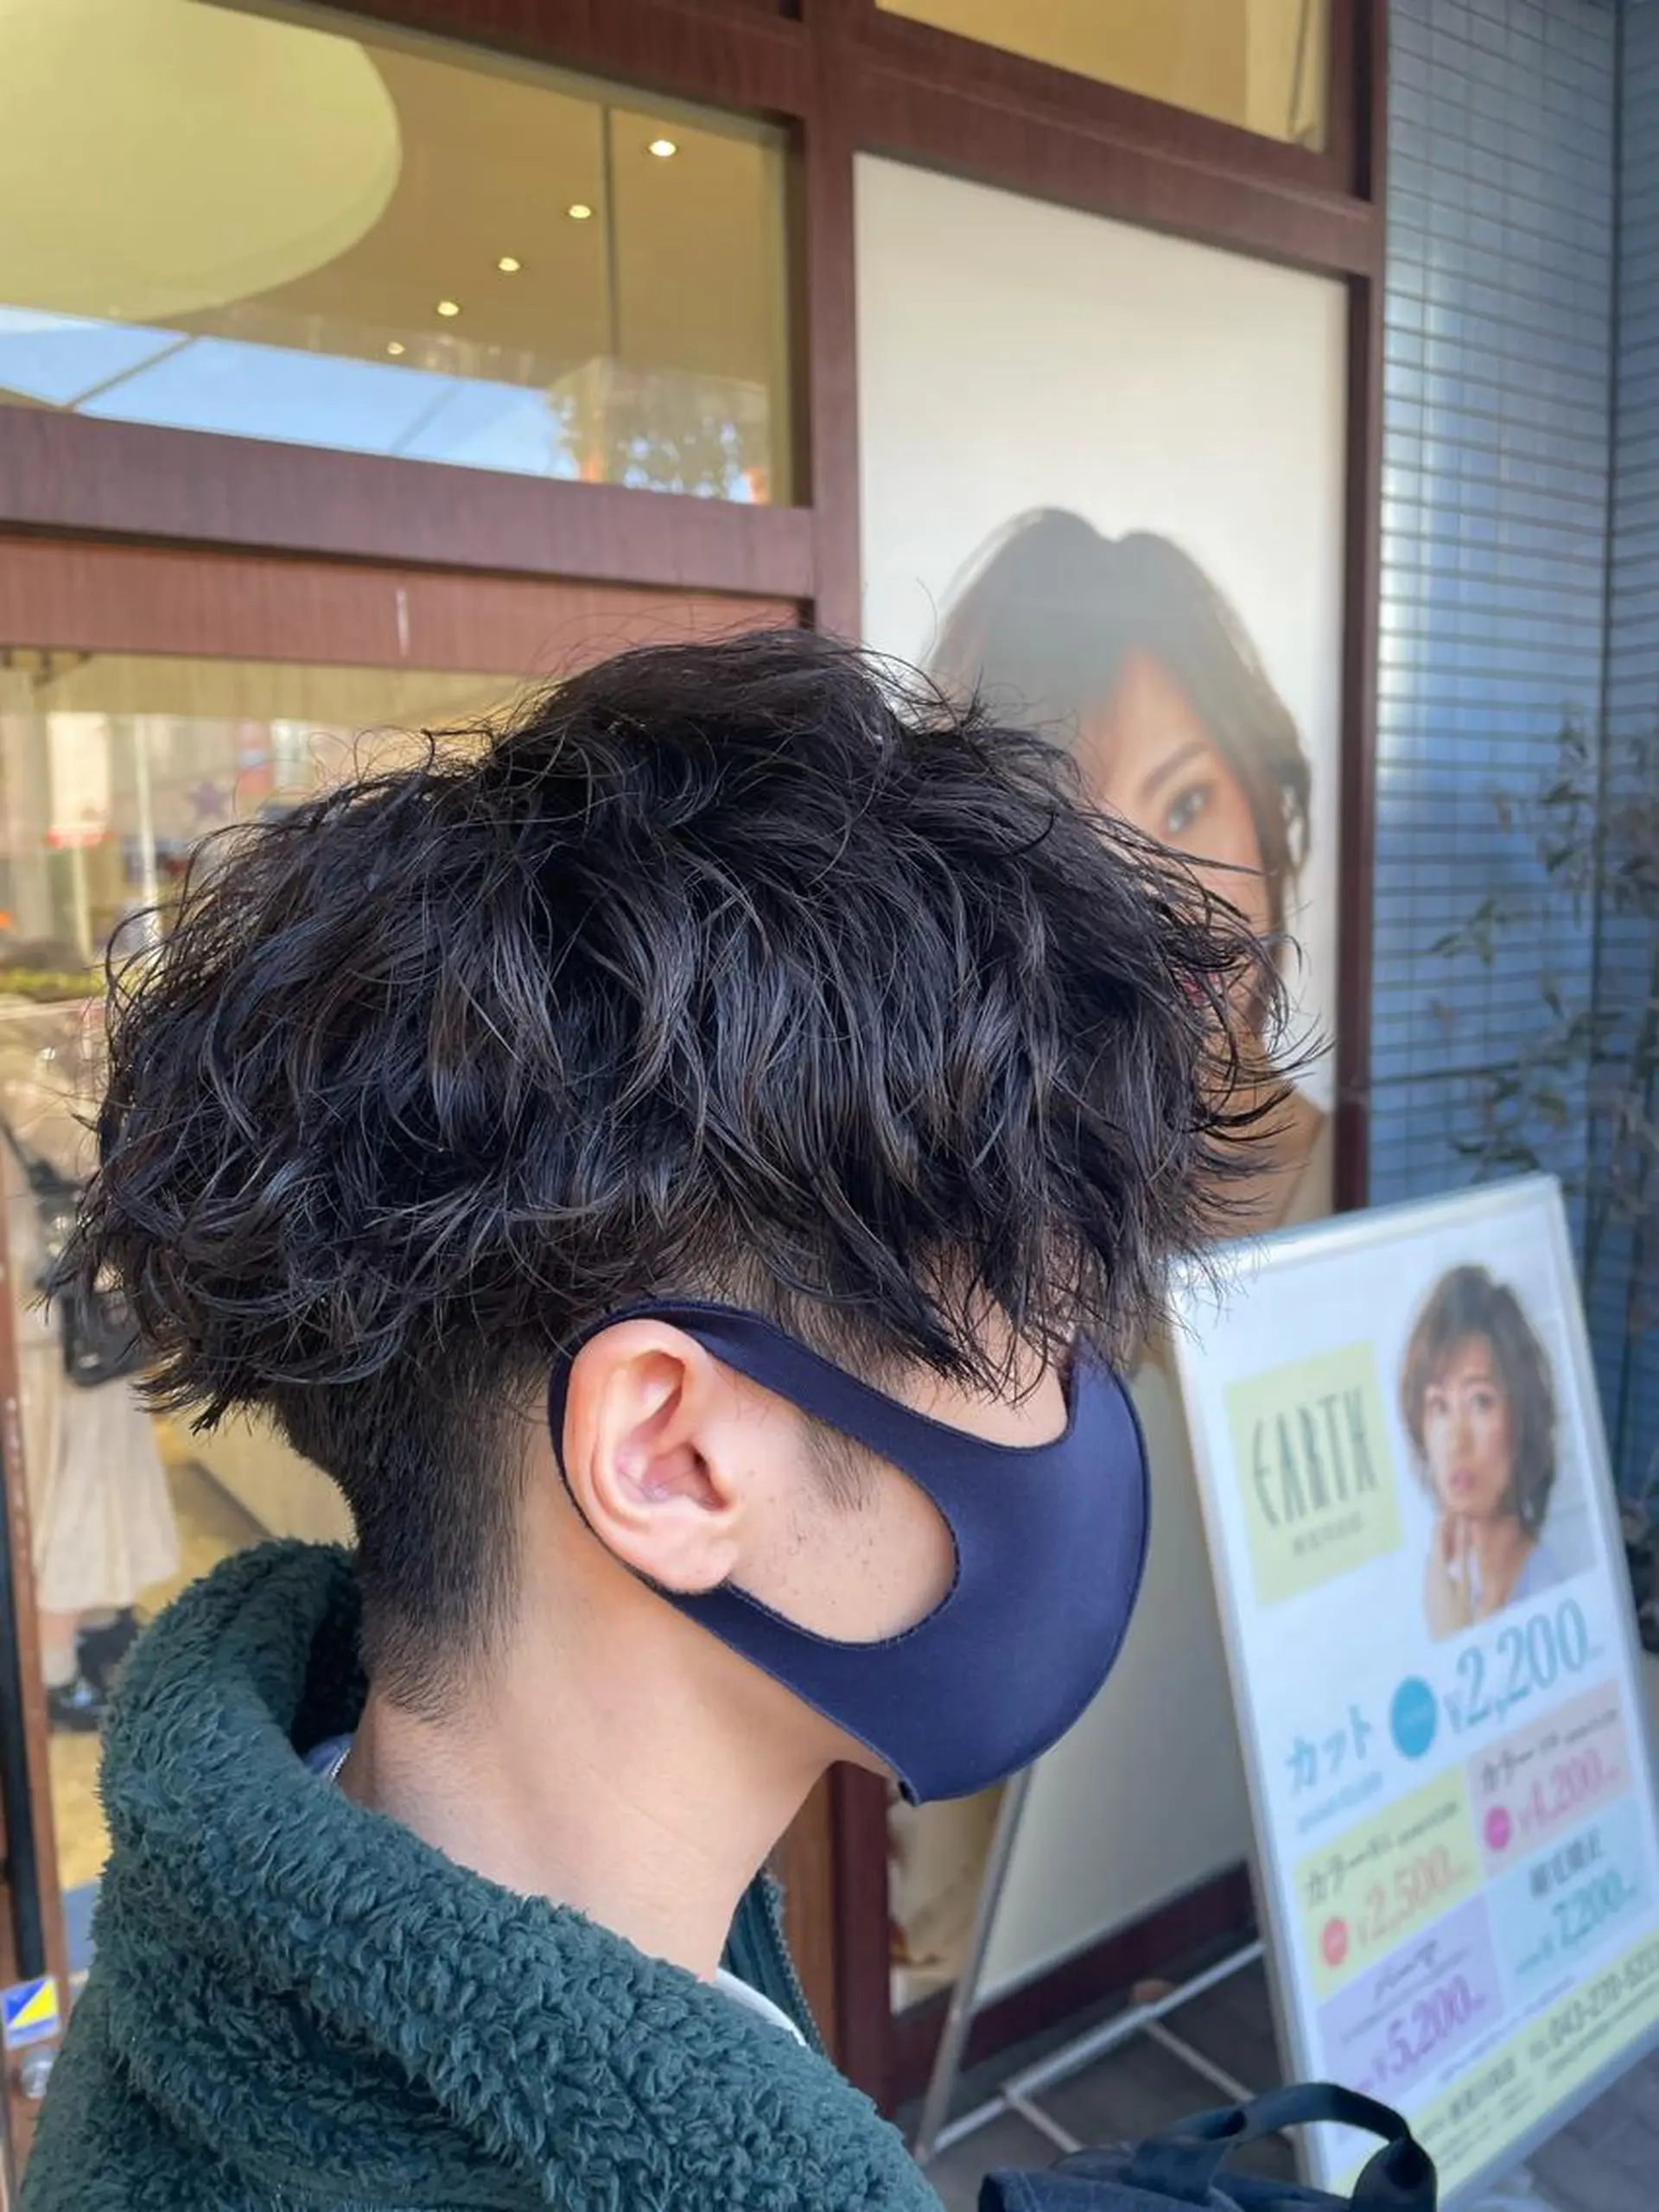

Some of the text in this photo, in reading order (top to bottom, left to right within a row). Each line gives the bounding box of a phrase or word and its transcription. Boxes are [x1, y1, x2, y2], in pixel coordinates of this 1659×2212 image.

[1251, 1387, 1379, 1529] EARTH
[1284, 1702, 1374, 1797] カット
